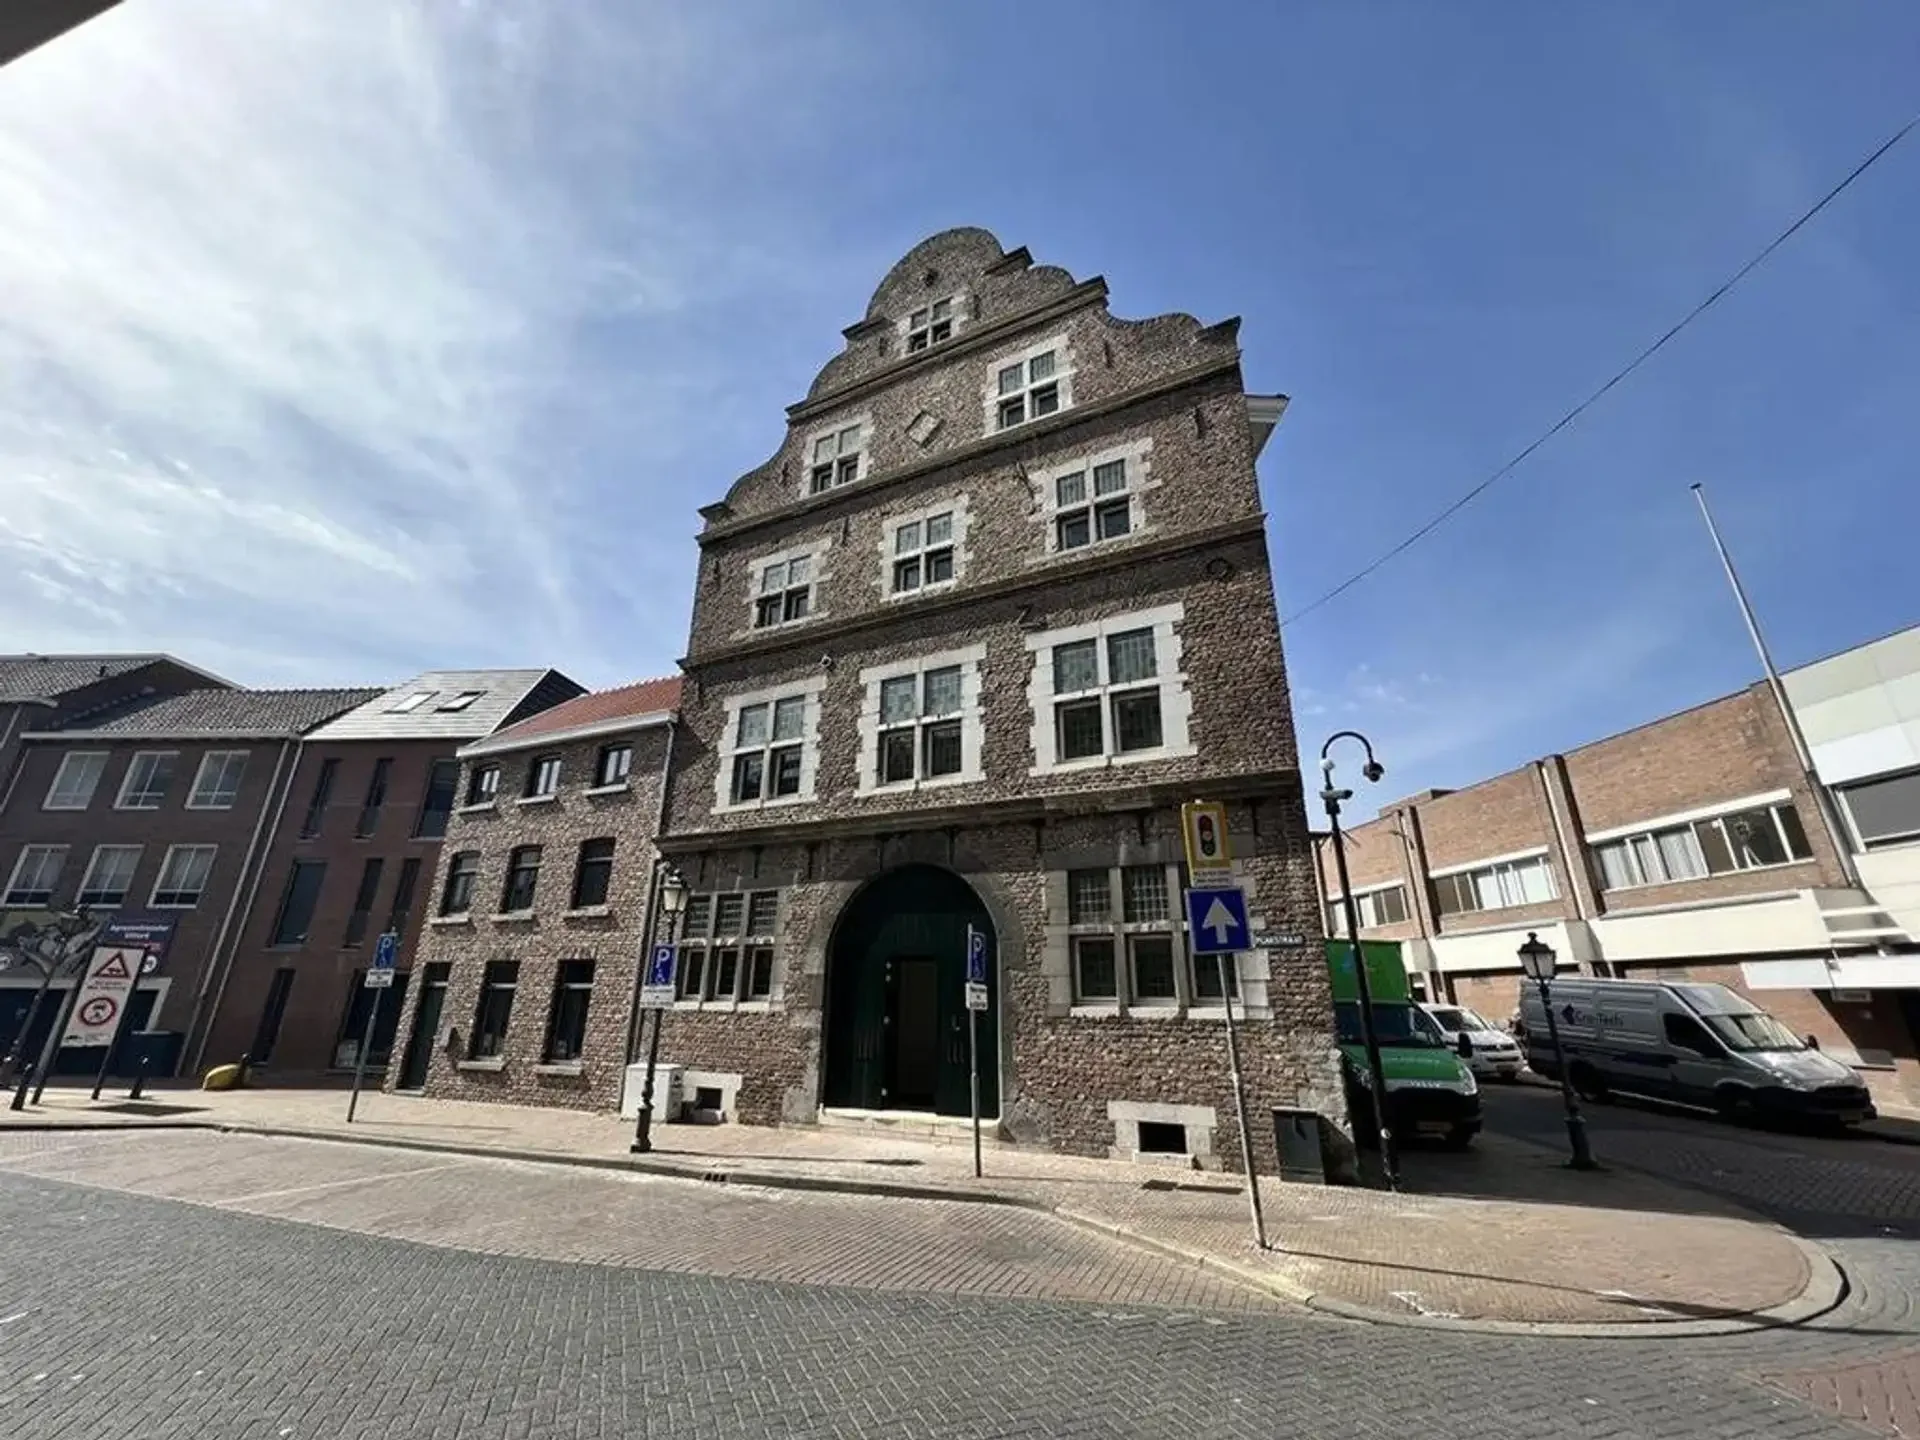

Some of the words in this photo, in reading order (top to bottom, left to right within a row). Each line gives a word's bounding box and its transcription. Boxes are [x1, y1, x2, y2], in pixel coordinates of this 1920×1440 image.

[379, 937, 392, 953] P
[973, 936, 982, 959] P
[655, 948, 670, 969] P
